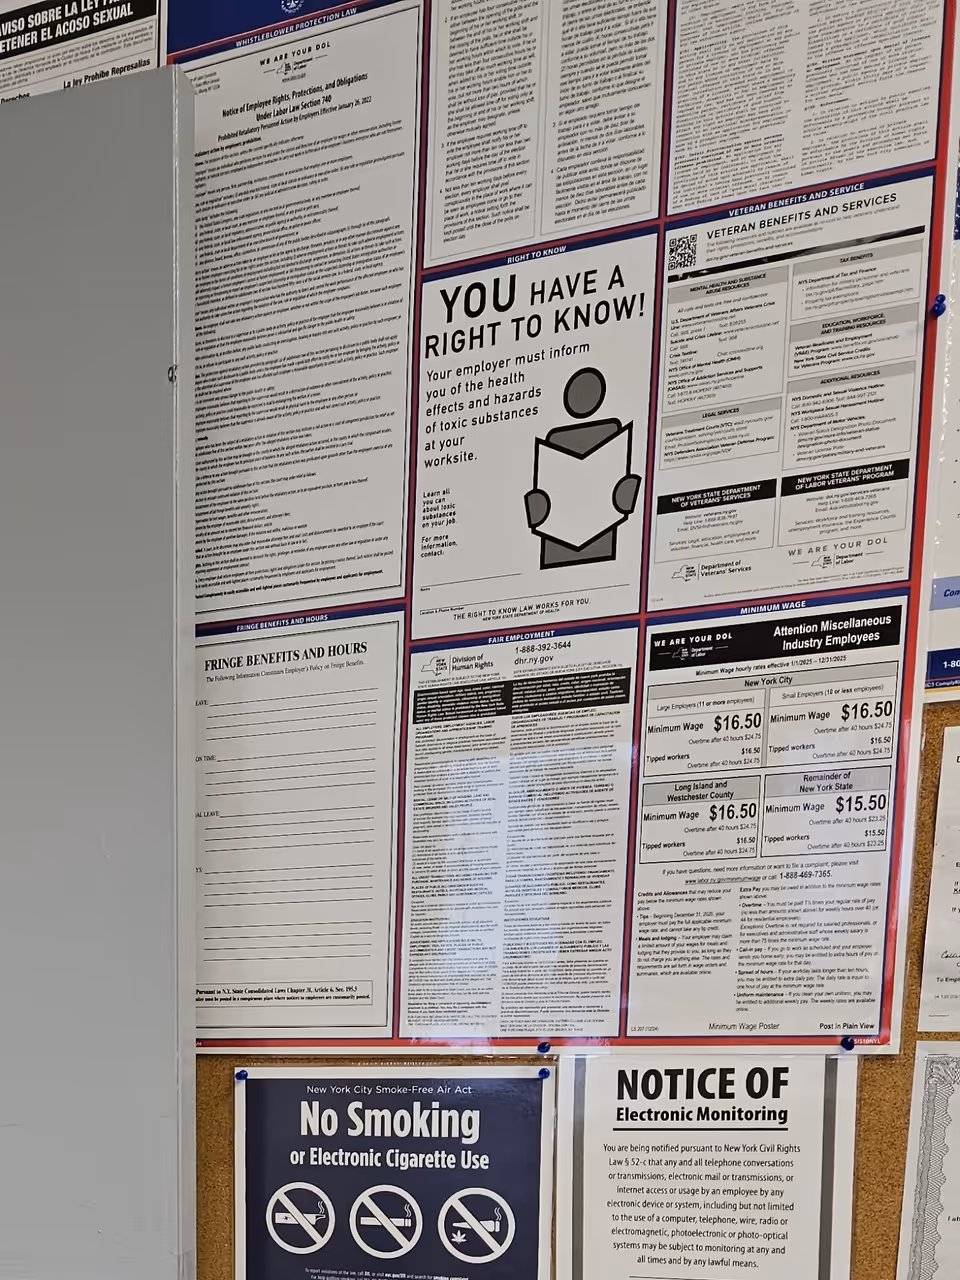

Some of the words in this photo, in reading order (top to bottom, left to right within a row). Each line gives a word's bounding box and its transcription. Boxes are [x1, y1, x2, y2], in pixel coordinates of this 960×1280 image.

[28, 6, 62, 28] SOBRE
[65, 2, 78, 17] LA
[41, 27, 53, 41] EL
[55, 15, 90, 37] ACOSO
[93, 4, 133, 26] SEXUAL
[235, 26, 294, 47] WHISTLEBLOWER
[295, 12, 340, 30] PROTECTION
[341, 7, 358, 17] LAW
[707, 222, 755, 239] VETERAN
[759, 210, 811, 229] BENEFITS
[814, 205, 838, 218] AND
[842, 193, 896, 212] SERVICES
[507, 253, 530, 264] RIGHT
[543, 245, 567, 256] KNOW
[531, 269, 597, 306] HAVE
[608, 265, 624, 290] A
[440, 274, 516, 323] YOU
[425, 321, 501, 359] RIGHT
[511, 314, 541, 341] TO
[555, 293, 645, 333] KNOW!
[427, 369, 452, 382] Your
[456, 358, 511, 376] employer
[516, 350, 545, 365] must
[550, 343, 590, 359] inform
[426, 388, 446, 402] you
[450, 382, 462, 395] of
[465, 380, 483, 392] the
[488, 371, 524, 388] health
[426, 401, 464, 417] effects
[468, 394, 489, 409] and
[494, 387, 541, 404] hazards
[426, 421, 436, 434] of
[440, 417, 467, 431] toxic
[471, 406, 538, 426] substances
[425, 440, 435, 451] at
[439, 436, 465, 451] your
[424, 451, 477, 468] worksite.
[740, 604, 780, 614] MINIMUM
[782, 600, 806, 609] WAGE
[505, 630, 557, 641] EMPLOYMENT
[773, 623, 818, 637] Attention
[821, 616, 891, 631] Miscellaneous
[516, 641, 571, 654] 1-888-392-3644
[783, 638, 823, 650] Industry
[825, 632, 880, 646] Employees
[204, 656, 243, 671] FRINGE
[247, 650, 300, 666] BENEFITS
[302, 647, 325, 660] AND
[328, 642, 367, 657] HOURS
[514, 656, 554, 665] dhr.ny.gov
[761, 677, 777, 685] York
[779, 676, 795, 687] City
[770, 714, 806, 723] Minimum
[808, 711, 830, 721] Wage
[841, 700, 895, 722] $16.50
[646, 723, 681, 734] Minimum
[683, 722, 704, 732] Wage
[714, 713, 761, 733] $16.50
[673, 781, 692, 792] Long
[693, 780, 713, 790] Island
[715, 780, 728, 788] and
[803, 772, 842, 782] Remainder
[843, 771, 851, 779] of
[667, 790, 708, 802] Westchester
[710, 791, 734, 800] County
[799, 785, 815, 793] New
[709, 803, 759, 822] $16.50
[766, 804, 801, 813] Minimum
[803, 803, 825, 812] Wage
[836, 794, 889, 814] $15.50
[644, 813, 676, 821] Minimum
[679, 811, 699, 820] Wage
[330, 1085, 350, 1093] York
[354, 1086, 372, 1095] City
[376, 1086, 434, 1094] Smoke-Free
[437, 1085, 451, 1093] Air
[454, 1086, 472, 1094] Act
[617, 1068, 735, 1100] NOTICE
[746, 1067, 789, 1099] OF
[301, 1101, 338, 1136] No
[347, 1101, 480, 1144] Smoking
[617, 1106, 693, 1121] Electronic
[696, 1106, 788, 1125] Monitoring
[290, 1151, 305, 1165] or
[310, 1147, 381, 1167] Electronic
[386, 1149, 456, 1170] Cigarette
[461, 1150, 489, 1169] Use
